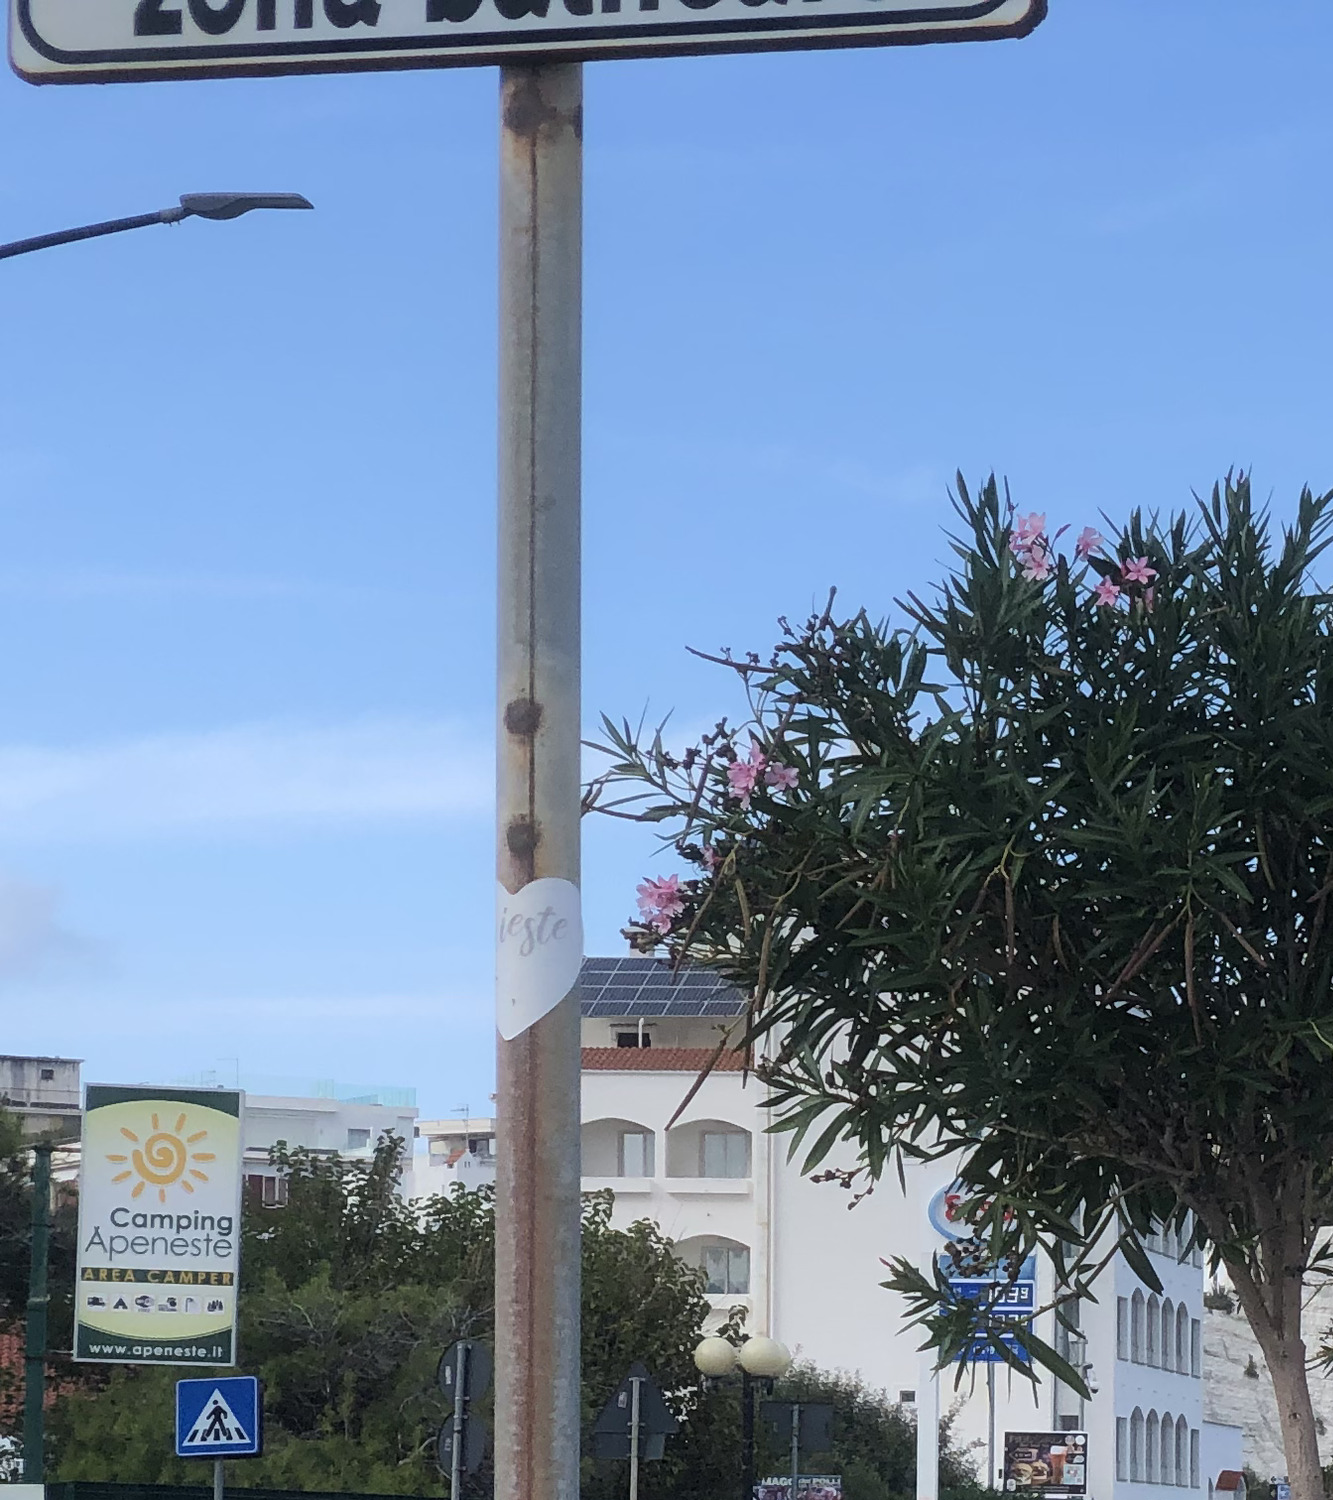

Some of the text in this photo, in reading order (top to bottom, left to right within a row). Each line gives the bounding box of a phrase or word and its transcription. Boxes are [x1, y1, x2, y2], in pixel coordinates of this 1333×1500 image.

[500, 906, 567, 957] ieste
[110, 1207, 233, 1236] Camping
[85, 1226, 233, 1261] Apeneste
[83, 1267, 231, 1285] AREA CAMPER
[88, 1344, 223, 1358] www.apeneste.it
